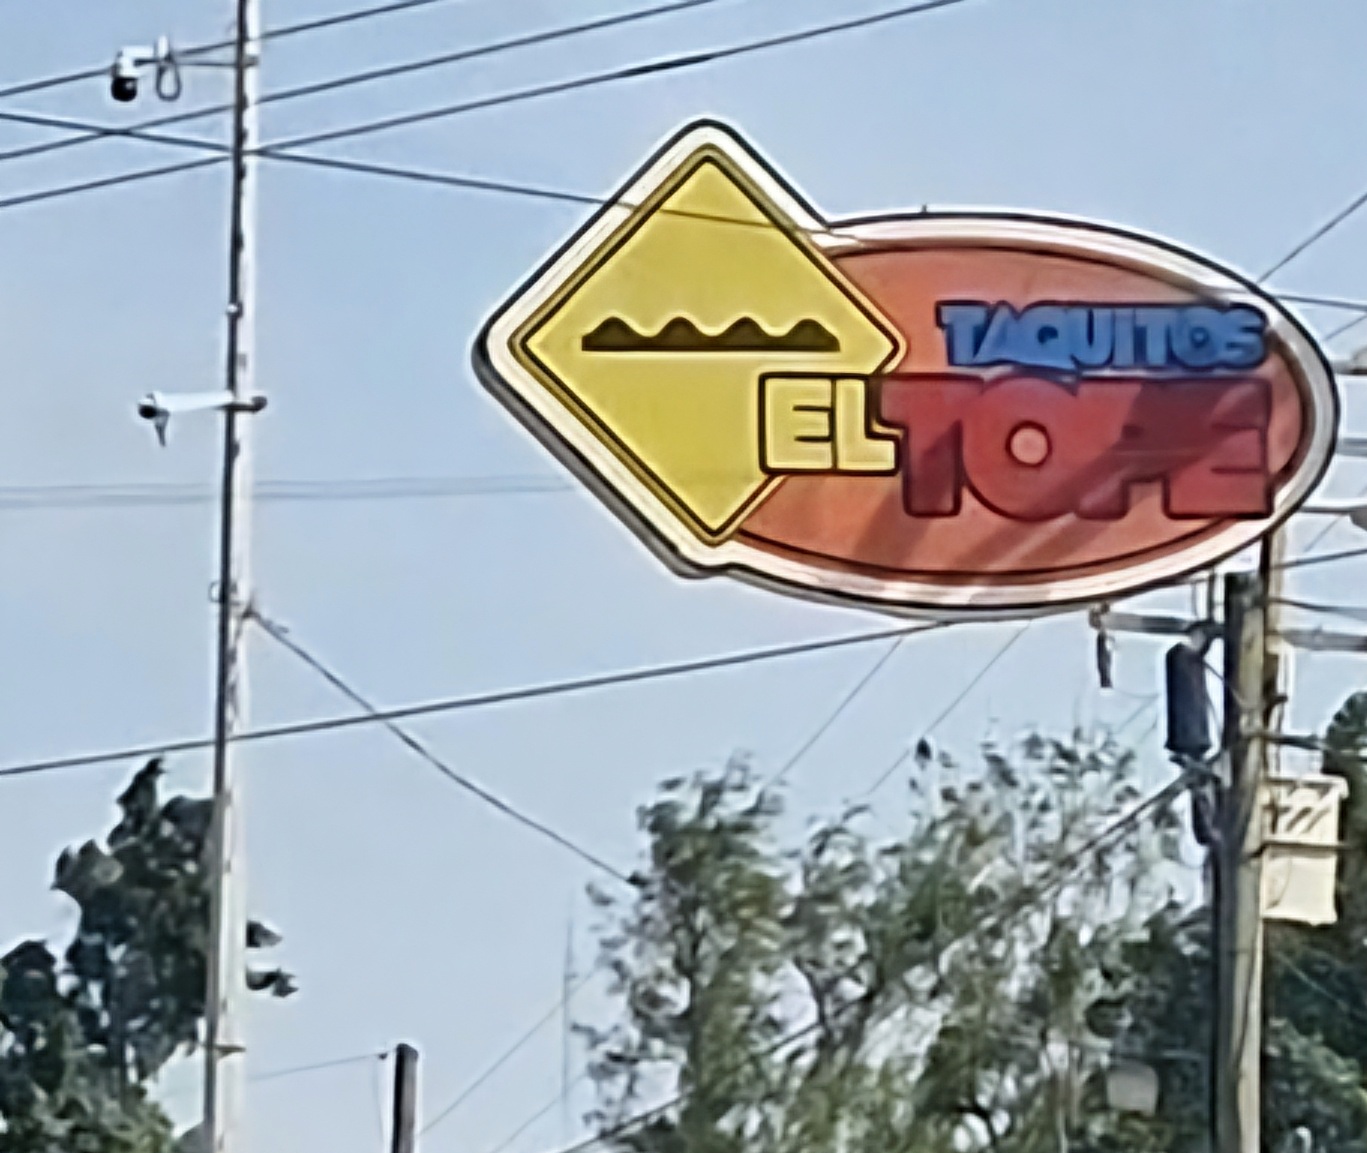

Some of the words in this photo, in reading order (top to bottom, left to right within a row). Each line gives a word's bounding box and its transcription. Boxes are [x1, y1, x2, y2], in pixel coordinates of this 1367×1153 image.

[937, 301, 1266, 372] TAQUITOS
[760, 374, 899, 474] EL
[877, 376, 1273, 519] TOPE
